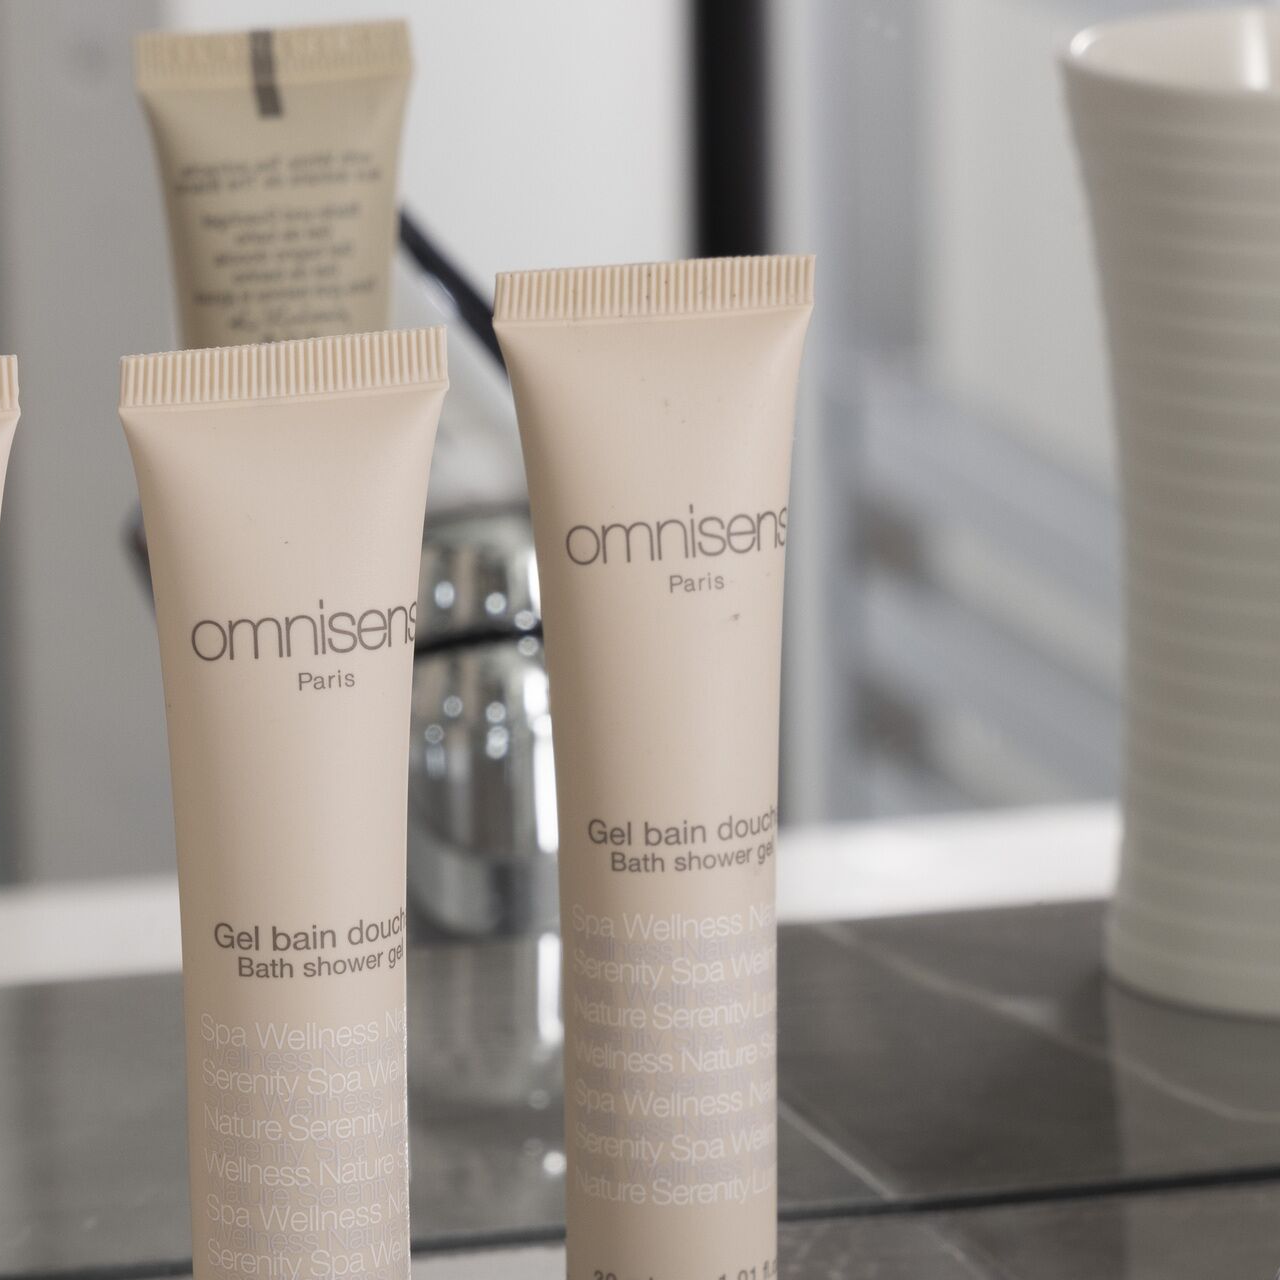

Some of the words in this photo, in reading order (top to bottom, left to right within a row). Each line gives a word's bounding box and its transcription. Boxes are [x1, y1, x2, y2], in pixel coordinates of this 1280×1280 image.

[566, 503, 788, 566] omnisens
[669, 572, 725, 593] Paris
[191, 599, 417, 661] omnisens
[298, 670, 355, 691] Paris
[587, 818, 632, 846] Gel
[644, 820, 706, 847] bain
[611, 851, 665, 873] Bath
[674, 847, 753, 872] shower
[214, 923, 259, 951] Gel
[272, 925, 336, 952] bain
[572, 903, 615, 939] Spa
[622, 912, 743, 940] Wellness
[238, 956, 294, 978] Bath
[303, 951, 383, 977] shower
[573, 948, 664, 990] Serenity
[671, 957, 725, 989] Spa
[575, 994, 647, 1029] Nature
[652, 999, 751, 1030] Serenity
[200, 1013, 248, 1050] Spa
[255, 1020, 380, 1050] Wellness
[575, 1038, 674, 1073] Wellness
[680, 1043, 758, 1073] Nature
[202, 1058, 300, 1102] Serenity
[307, 1067, 362, 1099] Spa
[575, 1078, 616, 1114] Spa
[622, 1090, 744, 1118] Wellness
[203, 1103, 282, 1141] Nature
[288, 1108, 388, 1141] Serenity
[575, 1121, 664, 1167] Serenity
[670, 1134, 725, 1166] Spa
[203, 1147, 311, 1187] Wellness
[320, 1153, 395, 1186] Nature
[575, 1165, 647, 1204] Nature
[652, 1173, 751, 1206] Serenity
[207, 1193, 250, 1228] Spa
[259, 1203, 382, 1232] Wellness
[310, 1249, 366, 1280] Spa
